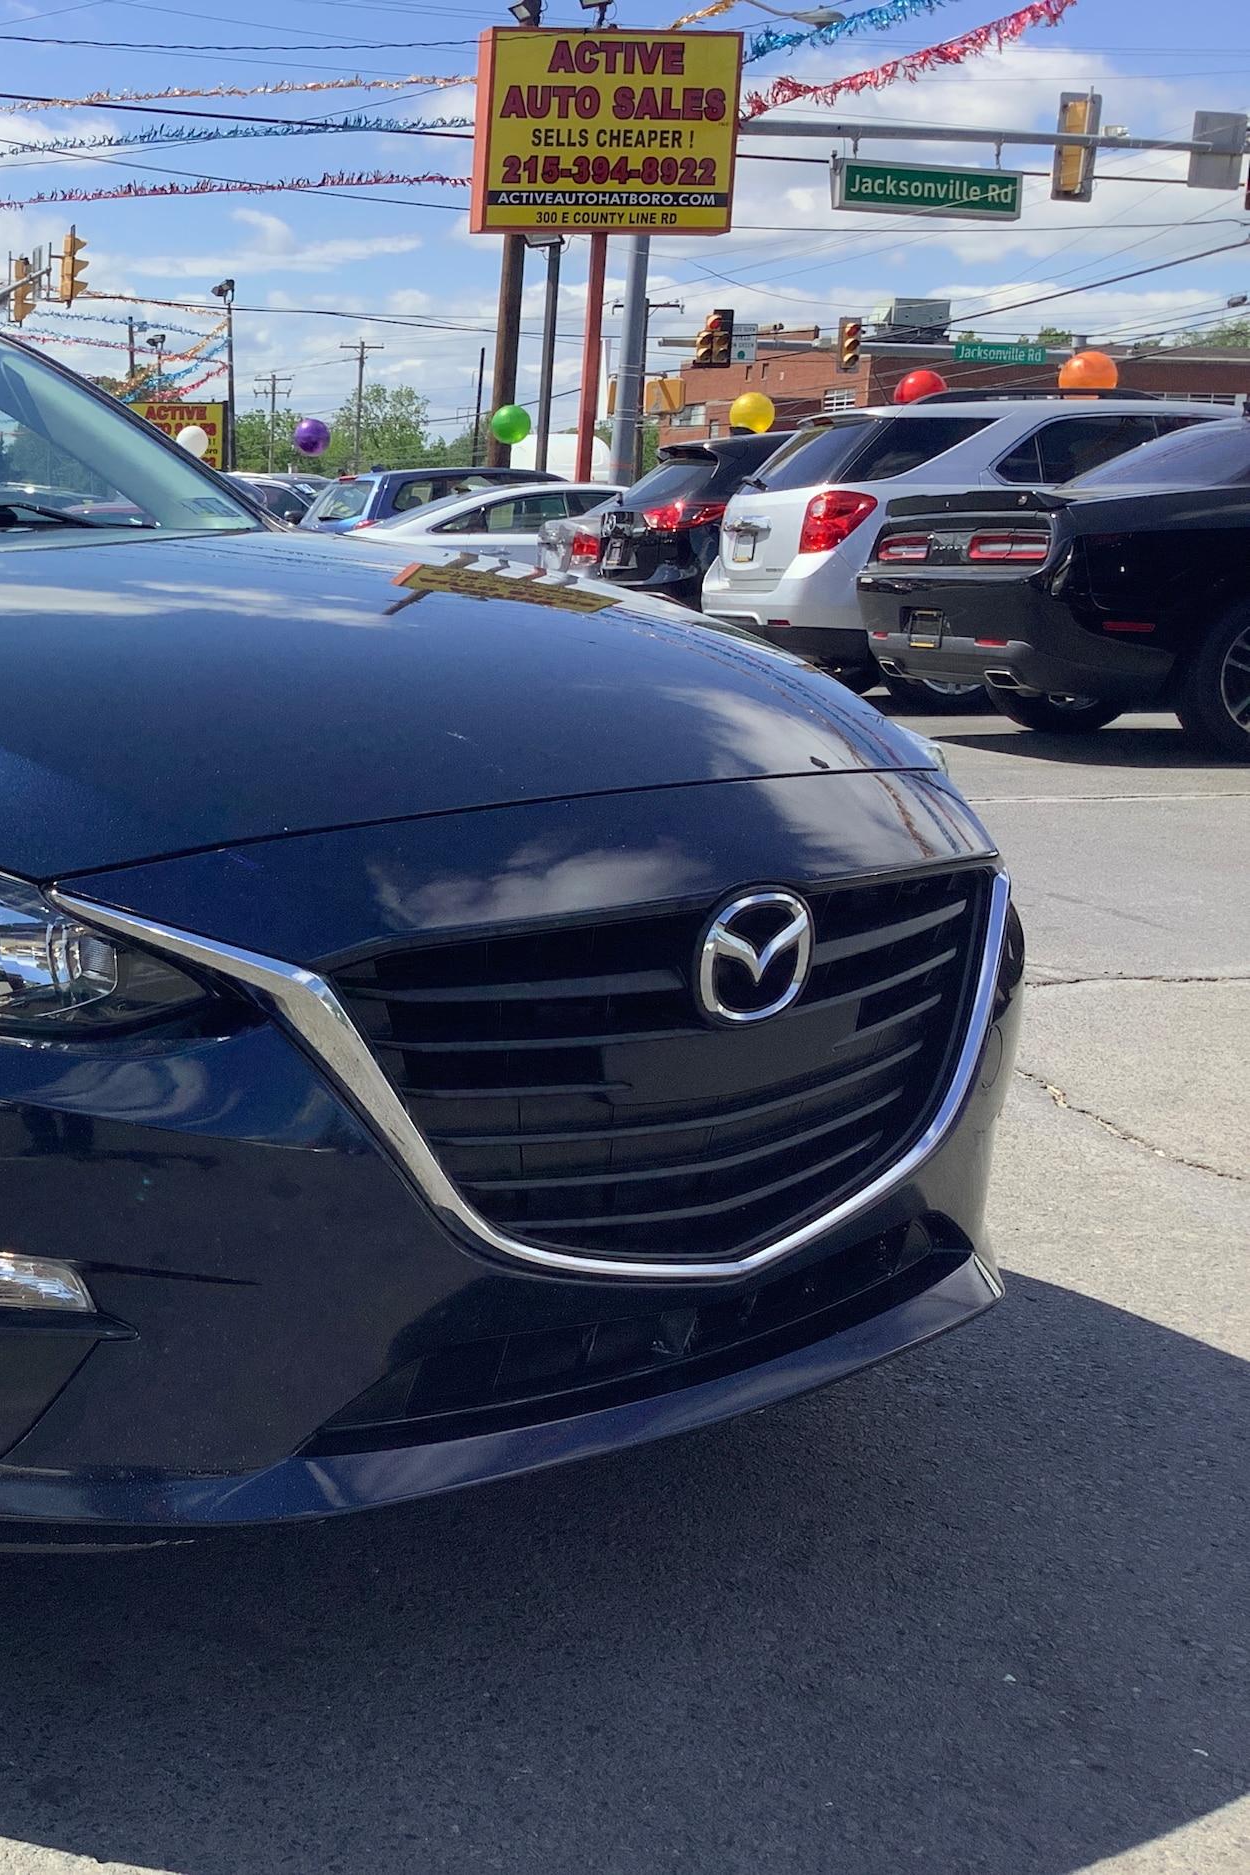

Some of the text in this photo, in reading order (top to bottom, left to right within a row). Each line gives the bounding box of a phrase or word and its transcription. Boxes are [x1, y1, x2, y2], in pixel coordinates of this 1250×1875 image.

[547, 39, 686, 76] ACTIVE
[499, 84, 727, 122] AUTO SALES
[531, 128, 589, 148] SELLS
[595, 129, 683, 149] CHEAPER
[501, 154, 717, 186] 215-394-8922
[497, 191, 716, 206] ACTIVEAUTOHATBORO.COM
[849, 173, 1013, 204] Jacksonville Rd
[535, 211, 678, 225] 300 E COUNTY LINE RD
[959, 345, 1042, 362] Jacksonville Rd
[145, 405, 207, 421] ACTIVE
